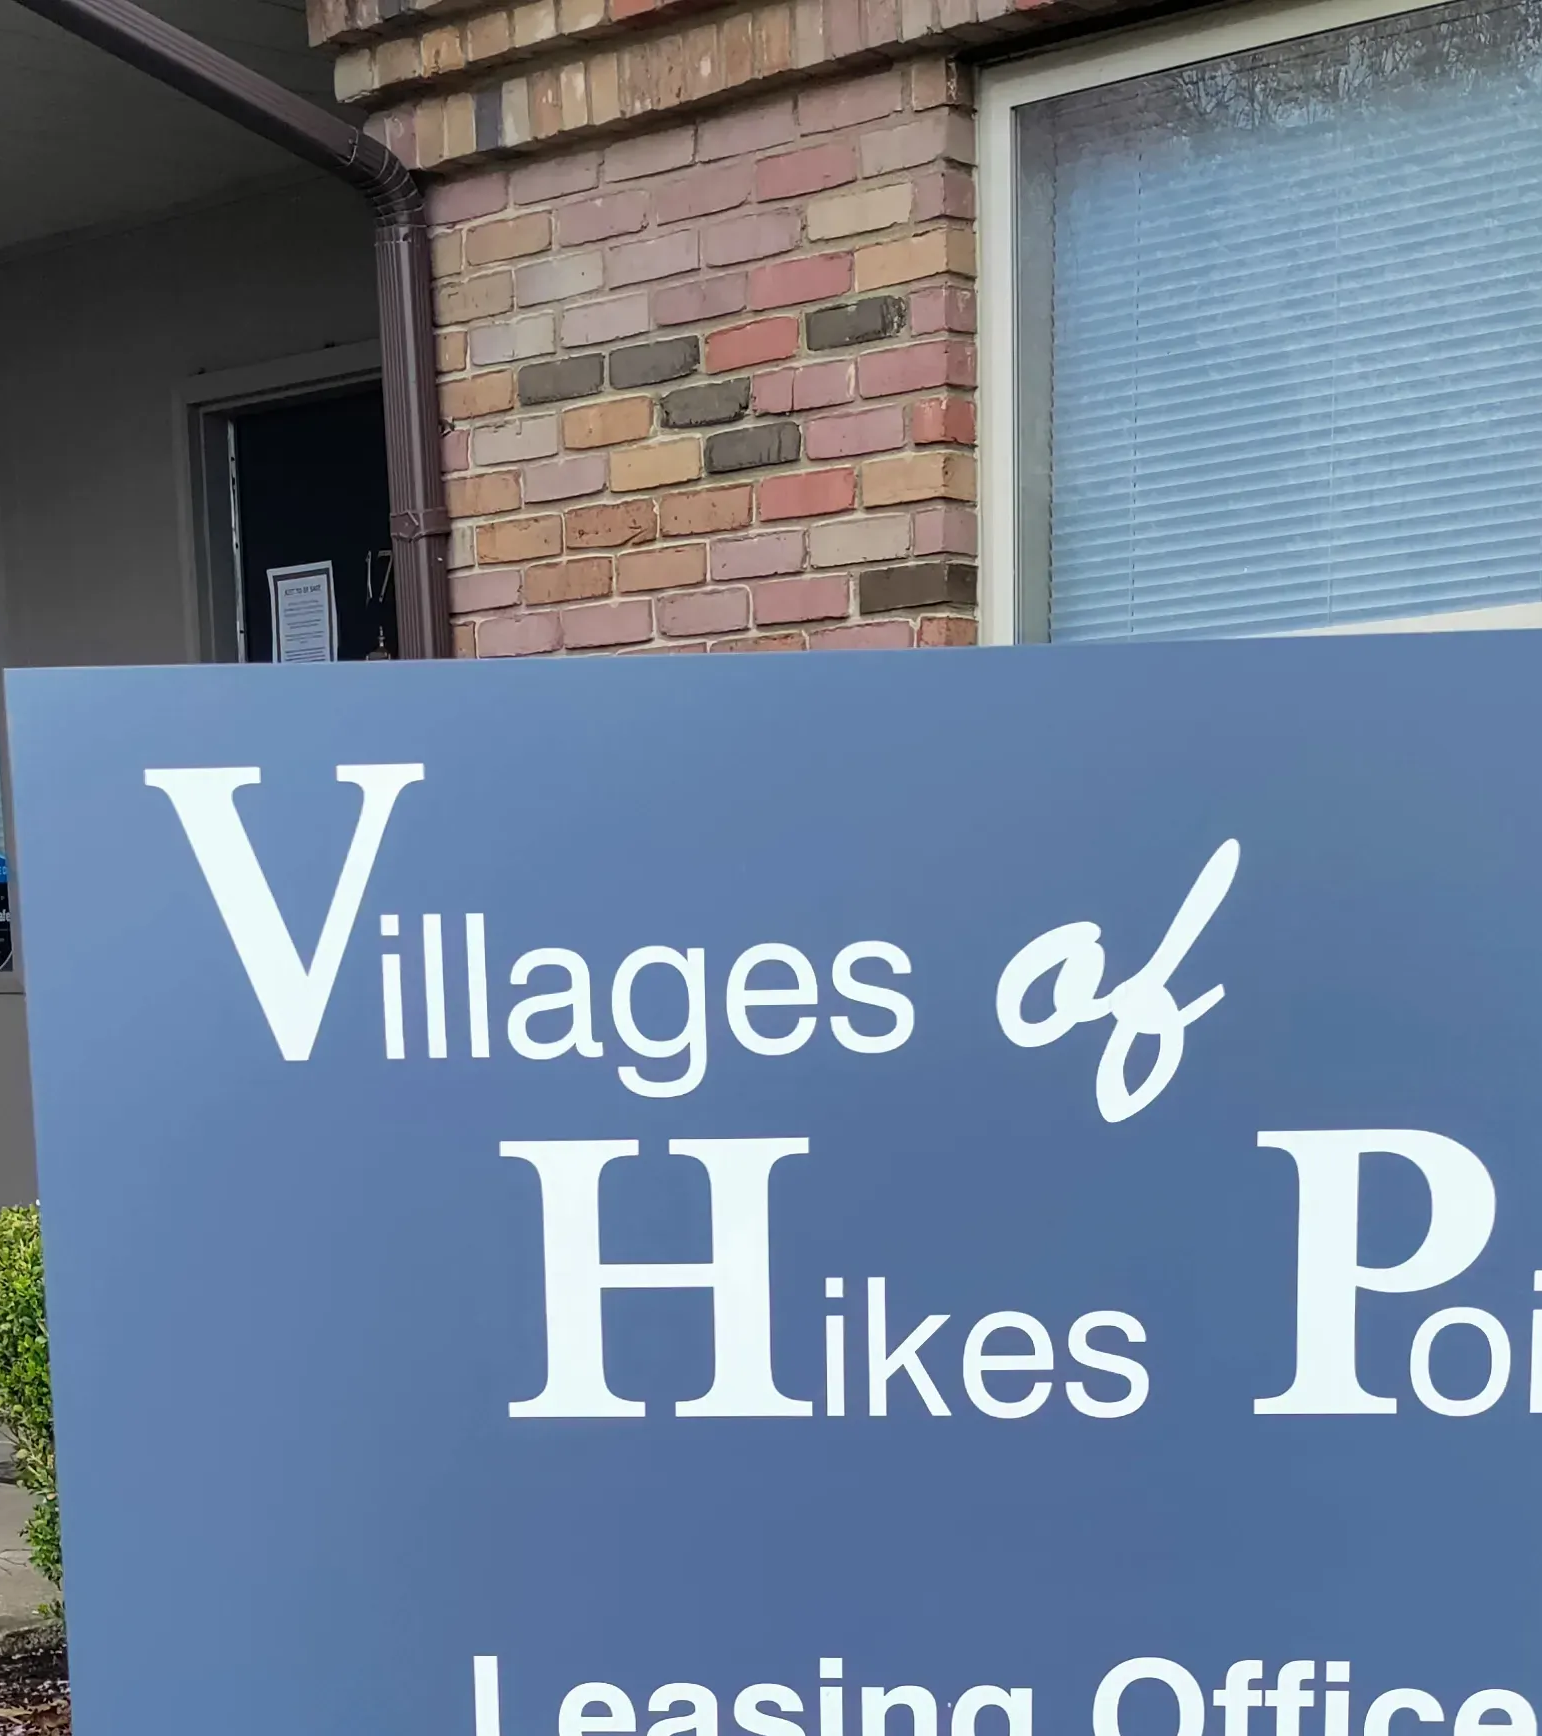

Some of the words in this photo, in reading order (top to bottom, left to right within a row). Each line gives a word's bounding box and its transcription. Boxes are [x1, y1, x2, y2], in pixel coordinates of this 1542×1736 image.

[144, 762, 915, 1098] Villages
[996, 838, 1240, 1123] of
[499, 1137, 1149, 1419] Hikes
